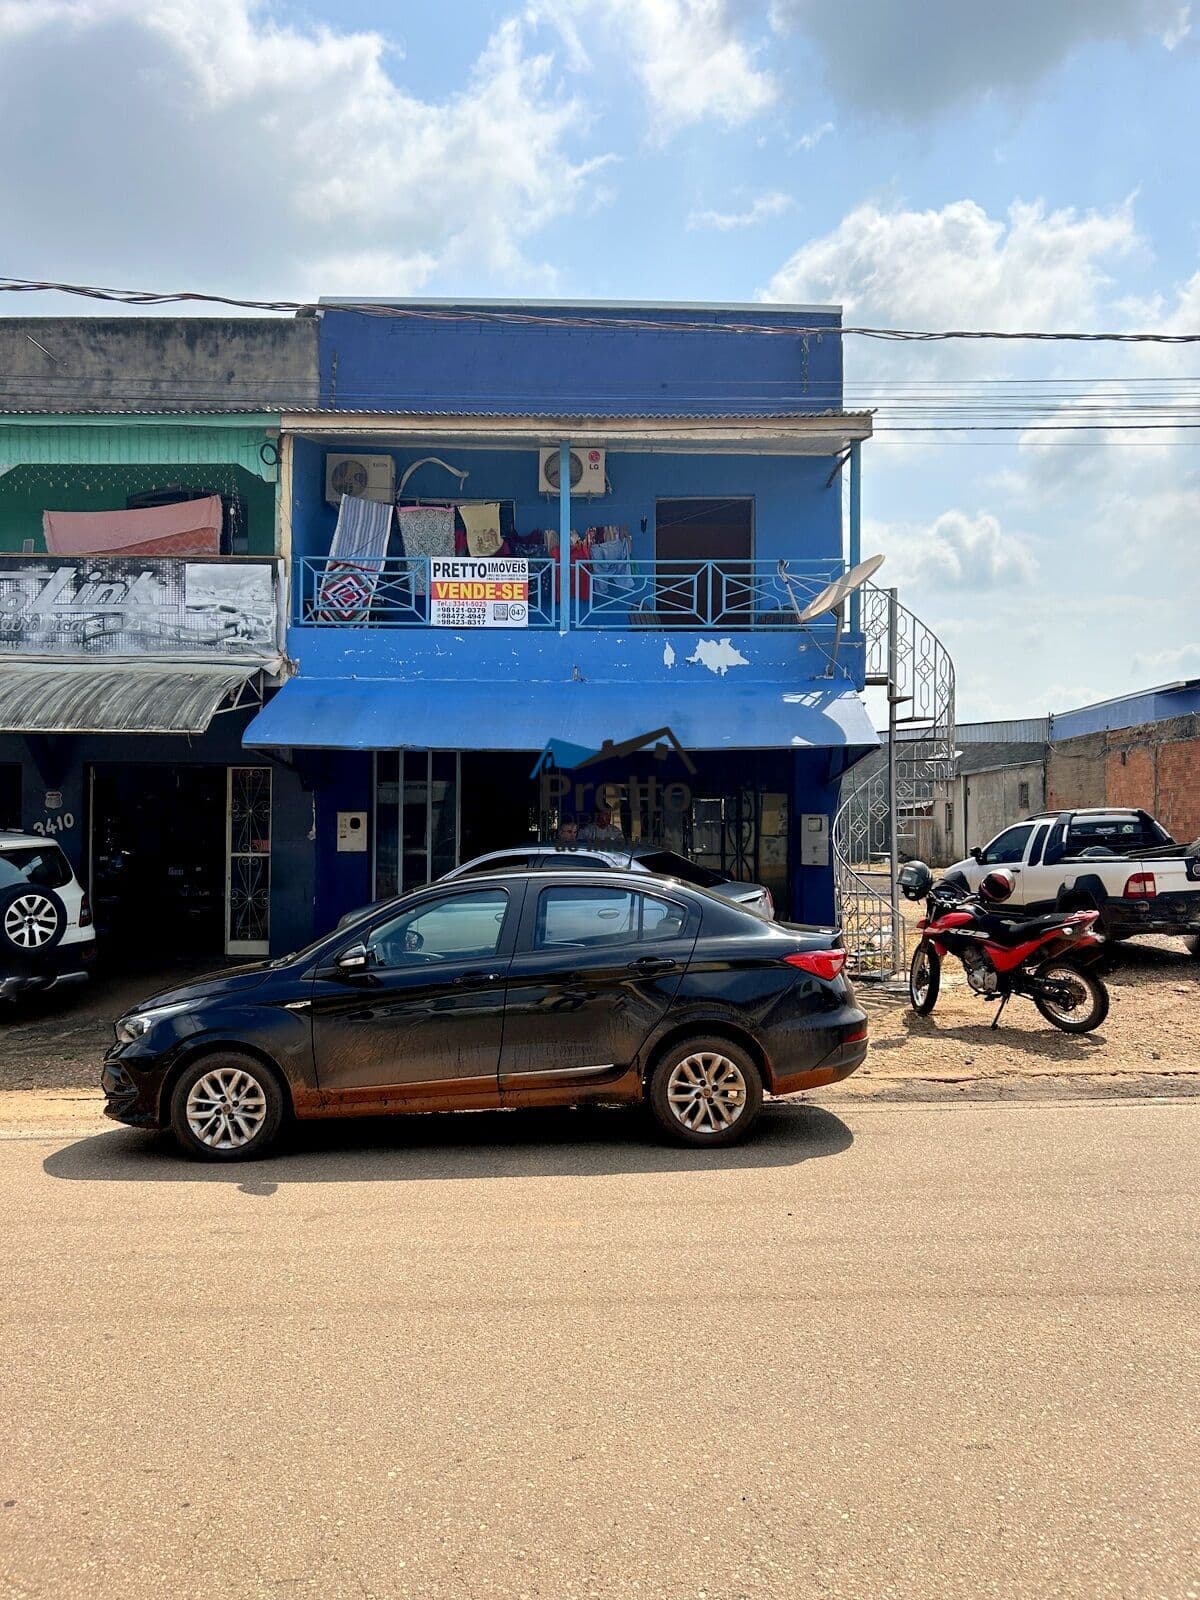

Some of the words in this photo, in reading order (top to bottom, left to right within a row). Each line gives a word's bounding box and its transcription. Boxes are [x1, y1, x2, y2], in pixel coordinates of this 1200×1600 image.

[433, 562, 487, 578] PRETTO
[487, 562, 526, 573] IMÓVEIS
[436, 583, 524, 600] VENDE-SE
[511, 608, 524, 616] 047
